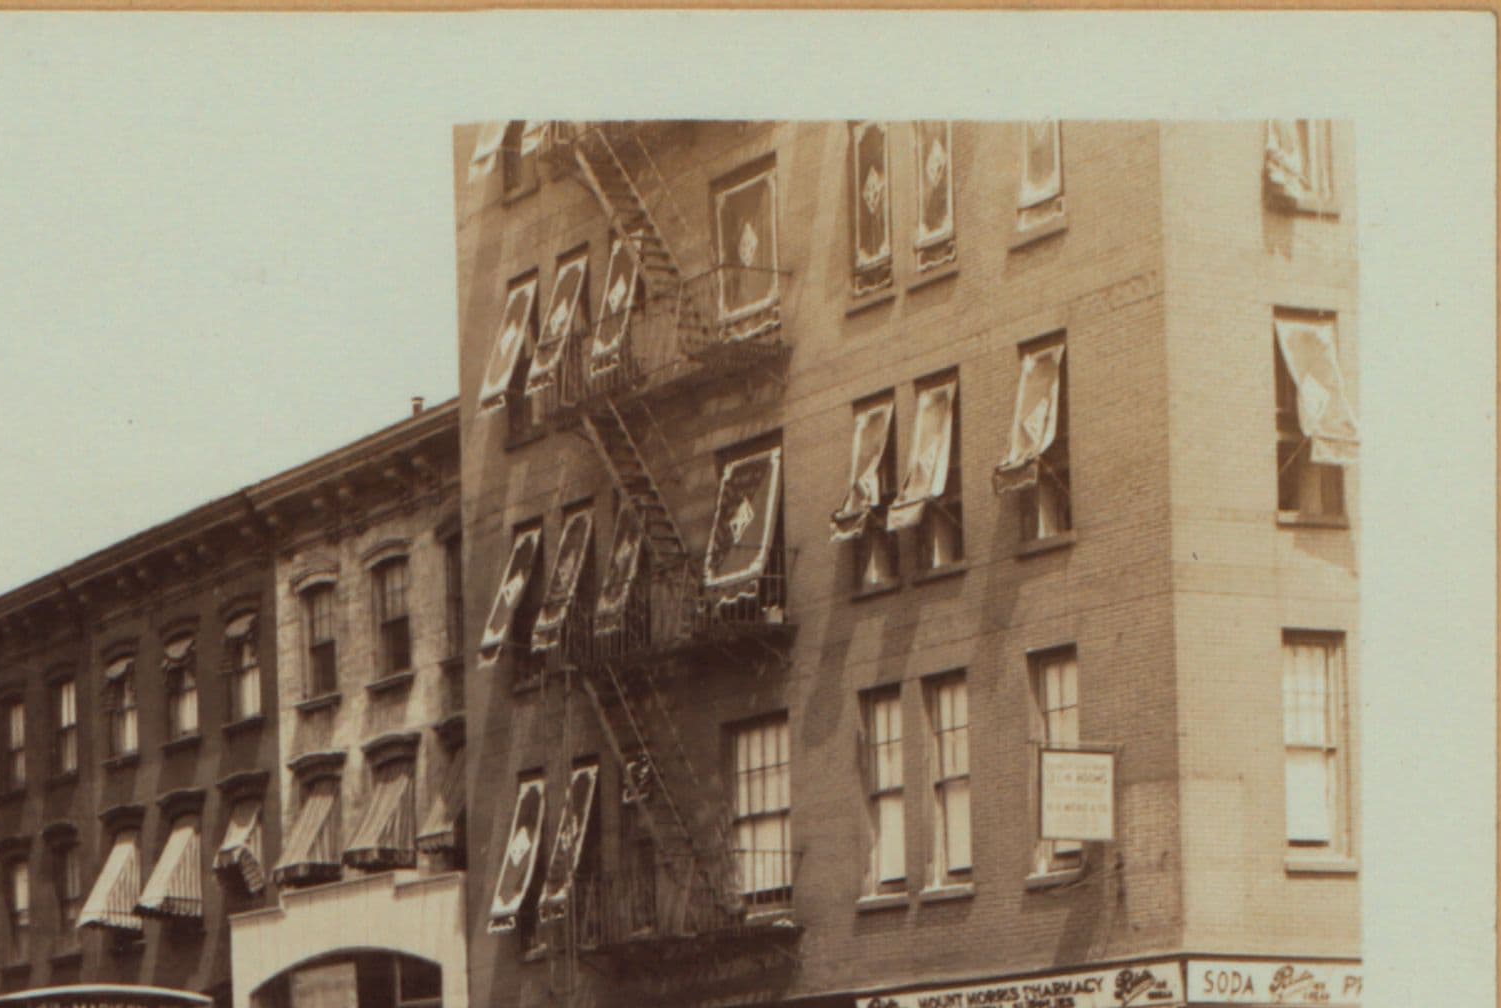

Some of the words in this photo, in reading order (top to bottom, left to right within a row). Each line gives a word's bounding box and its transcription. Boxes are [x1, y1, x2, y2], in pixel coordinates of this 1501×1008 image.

[965, 986, 1020, 1007] MORRIS
[1023, 976, 1105, 1001] PHARMACY
[1203, 970, 1255, 995] SODA
